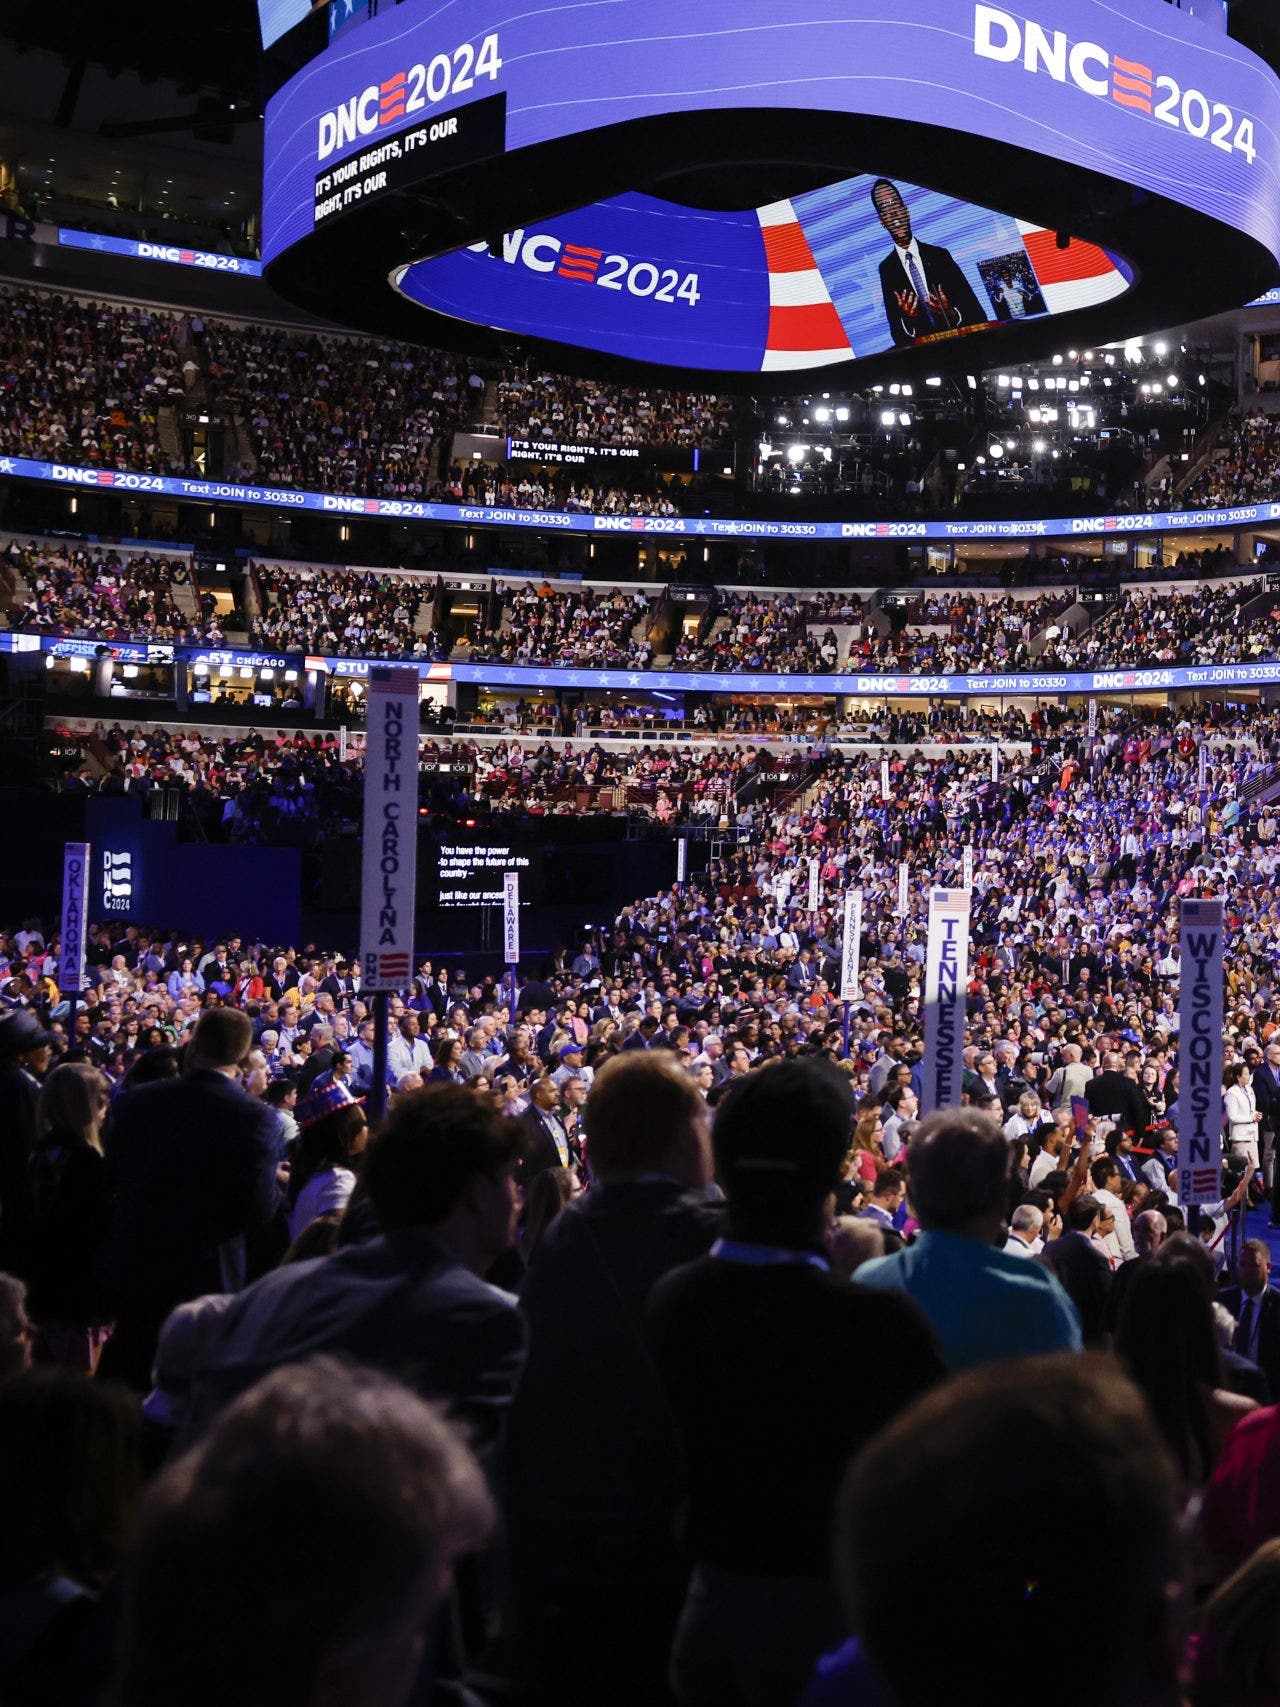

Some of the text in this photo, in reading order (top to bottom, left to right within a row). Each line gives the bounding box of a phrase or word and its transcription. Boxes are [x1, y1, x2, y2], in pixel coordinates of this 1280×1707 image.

[974, 3, 1257, 165] DNC 2024
[318, 33, 503, 161] DNC 2024
[316, 117, 458, 198] IT'S YOUR RIGHTS, IT'S OUR
[314, 171, 387, 222] RIGHT, IT'S OUR
[137, 243, 240, 271] DNC 2024
[596, 255, 701, 307] 2024
[511, 450, 586, 464] RIGHT, IT'S OUR
[512, 440, 640, 458] IT'S YOUR RIGHTS, IT'S OUR
[52, 465, 165, 491] DNC 2024
[182, 482, 304, 504] Text JOIN to 30330
[323, 495, 424, 517] DNC 2024
[459, 508, 571, 526] Text JOIN to 30330
[1166, 506, 1257, 524] Text JOIN to 30330
[594, 516, 686, 533] DNC 2024
[841, 523, 926, 536] DNC 2024
[1072, 513, 1153, 532] DNC 2024
[236, 656, 286, 668] CHICAGO
[857, 676, 948, 691] DNC 2024
[966, 675, 1066, 688] Text JOIN to 30330
[1093, 669, 1170, 685] DNC 2024
[379, 702, 403, 946] NORTH CAROLINA
[440, 846, 510, 857] You have the power
[449, 857, 472, 868] shape
[472, 857, 485, 867] the
[486, 857, 507, 867] future
[507, 857, 516, 867] of
[516, 857, 530, 867] this
[104, 851, 132, 911] DNC 2024
[440, 869, 468, 880] country
[439, 890, 454, 902] just
[454, 890, 469, 901] like
[469, 891, 483, 901] our
[65, 859, 81, 971] OKLAHOMA
[506, 884, 516, 950] DELAWARE
[846, 903, 857, 984] PENNSYLVANIA
[365, 953, 377, 988] DNC
[1186, 933, 1218, 1164] WISCONSIN
